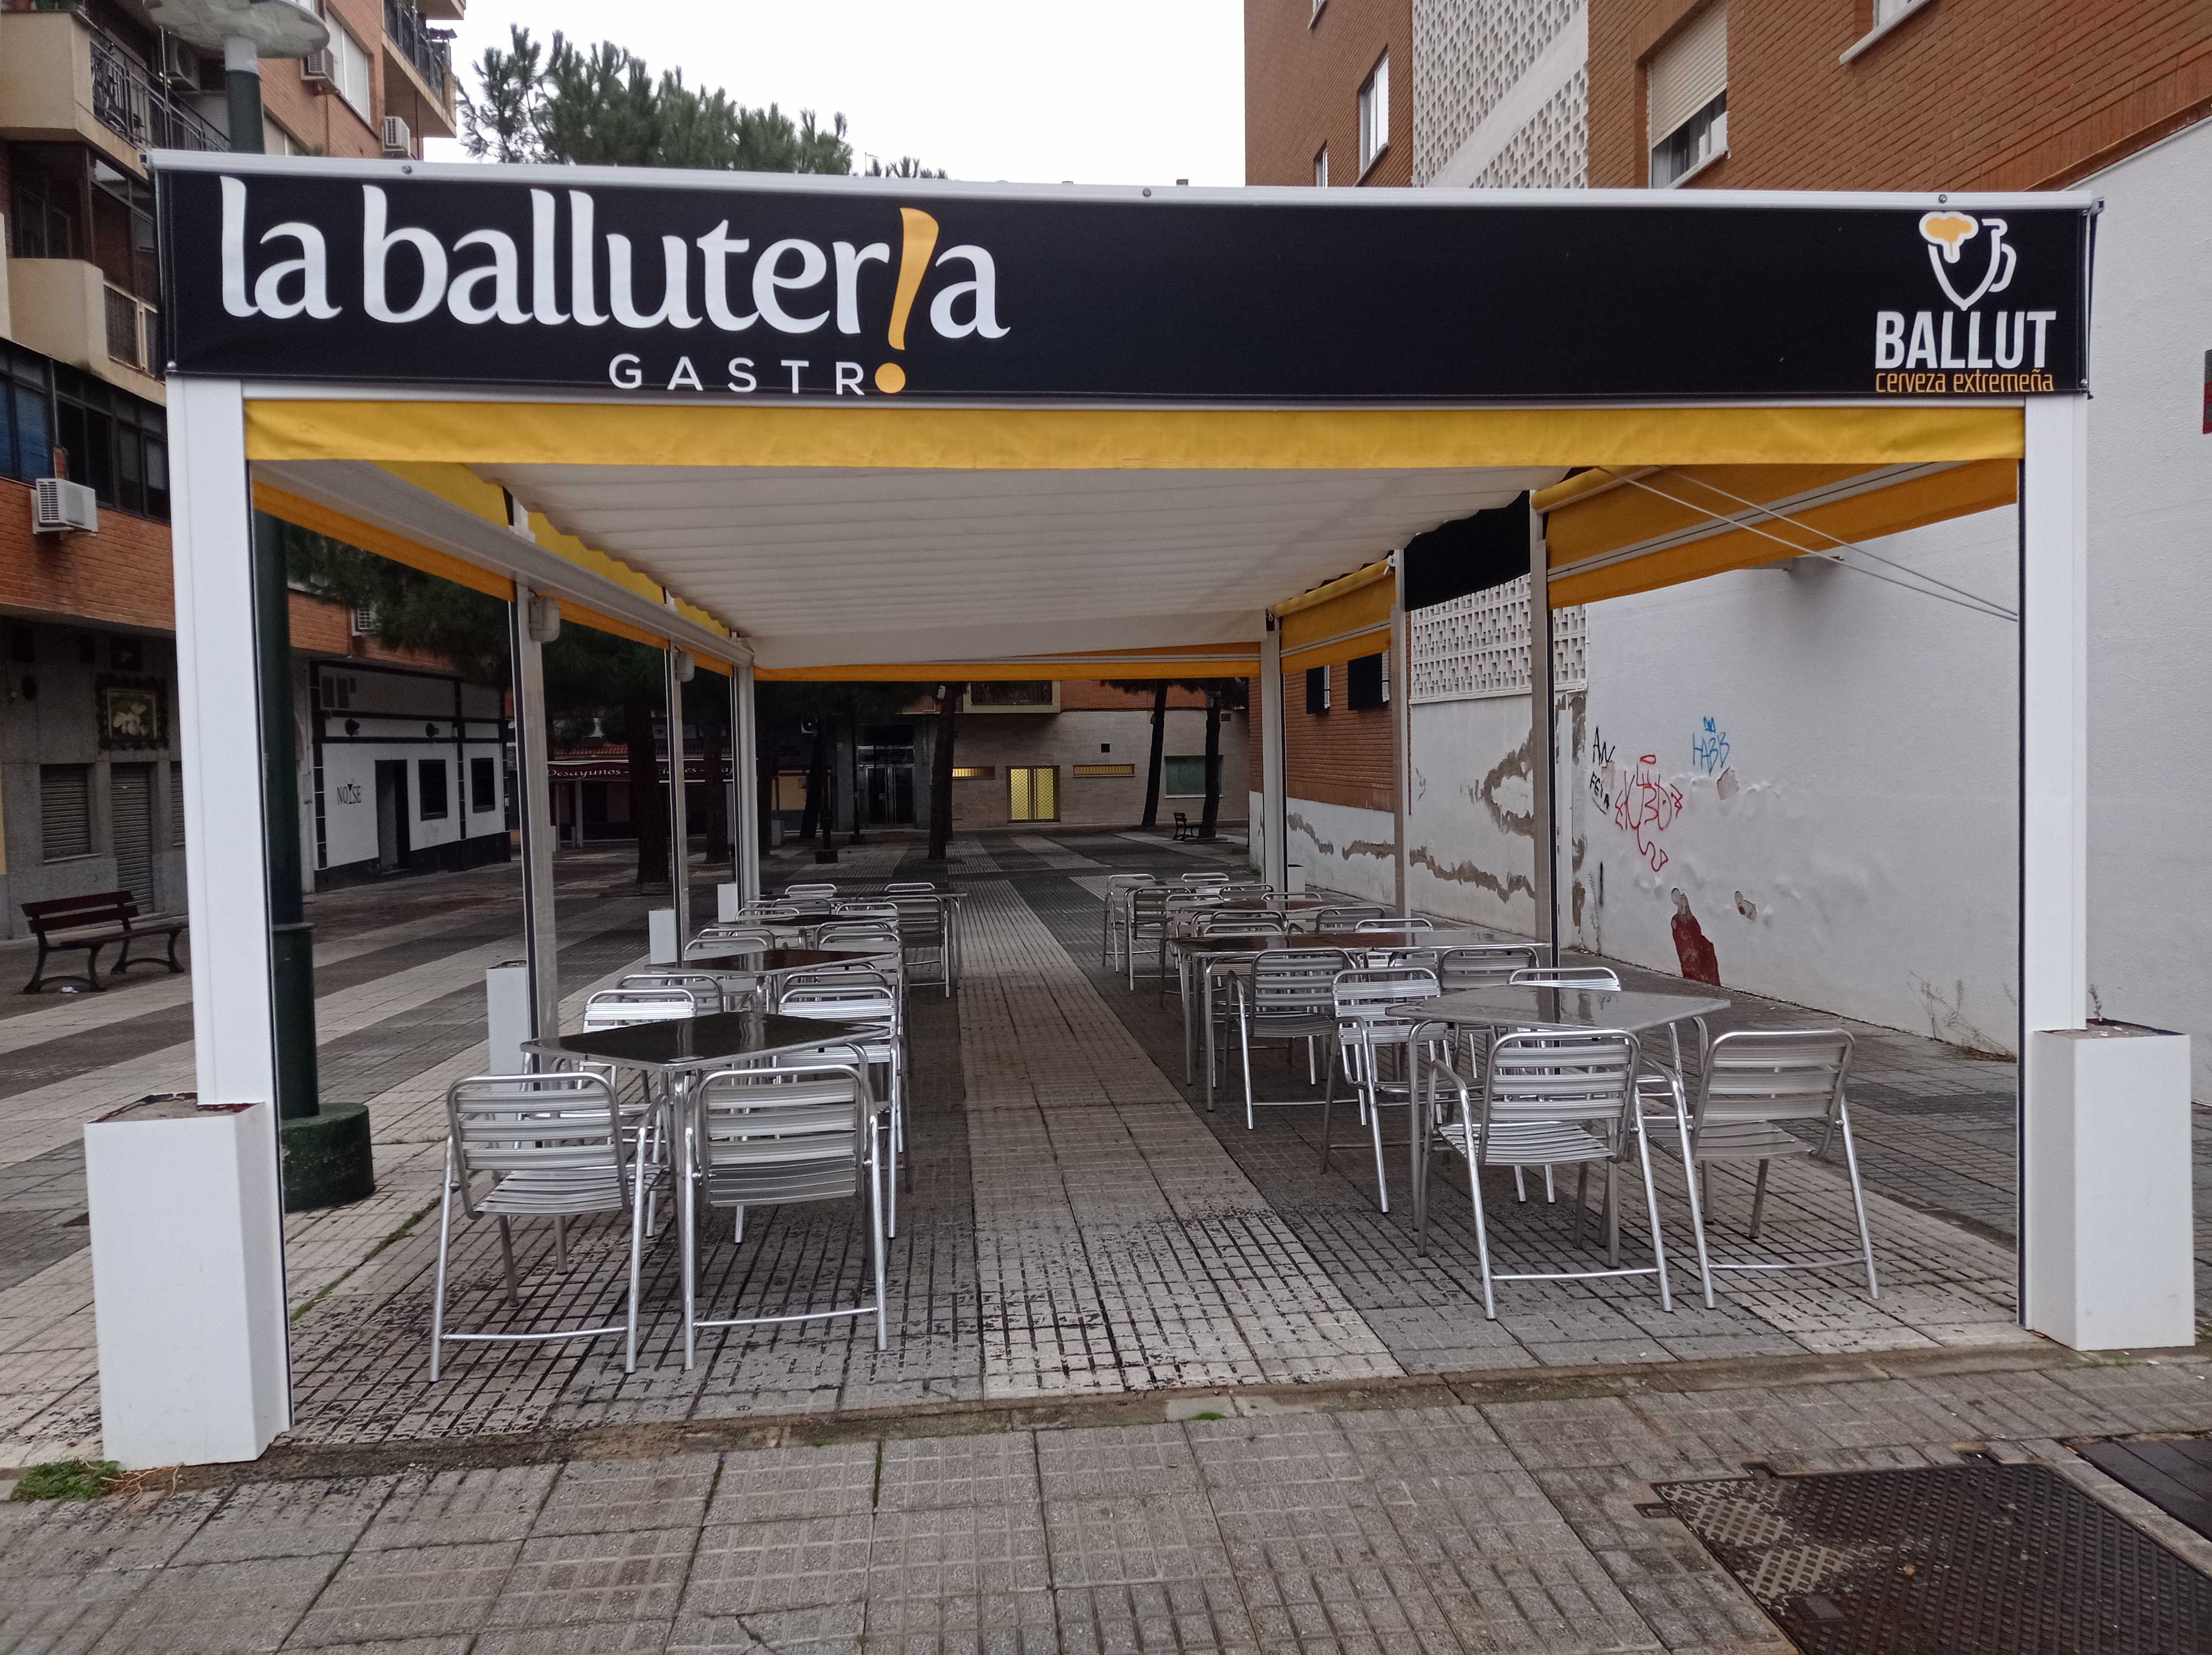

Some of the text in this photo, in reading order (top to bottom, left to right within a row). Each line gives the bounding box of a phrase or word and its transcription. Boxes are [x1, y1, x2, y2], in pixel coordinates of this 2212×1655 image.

[219, 175, 343, 319] la
[1875, 311, 2057, 369] BALLUT
[1875, 369, 2056, 393] cerveza extremeña
